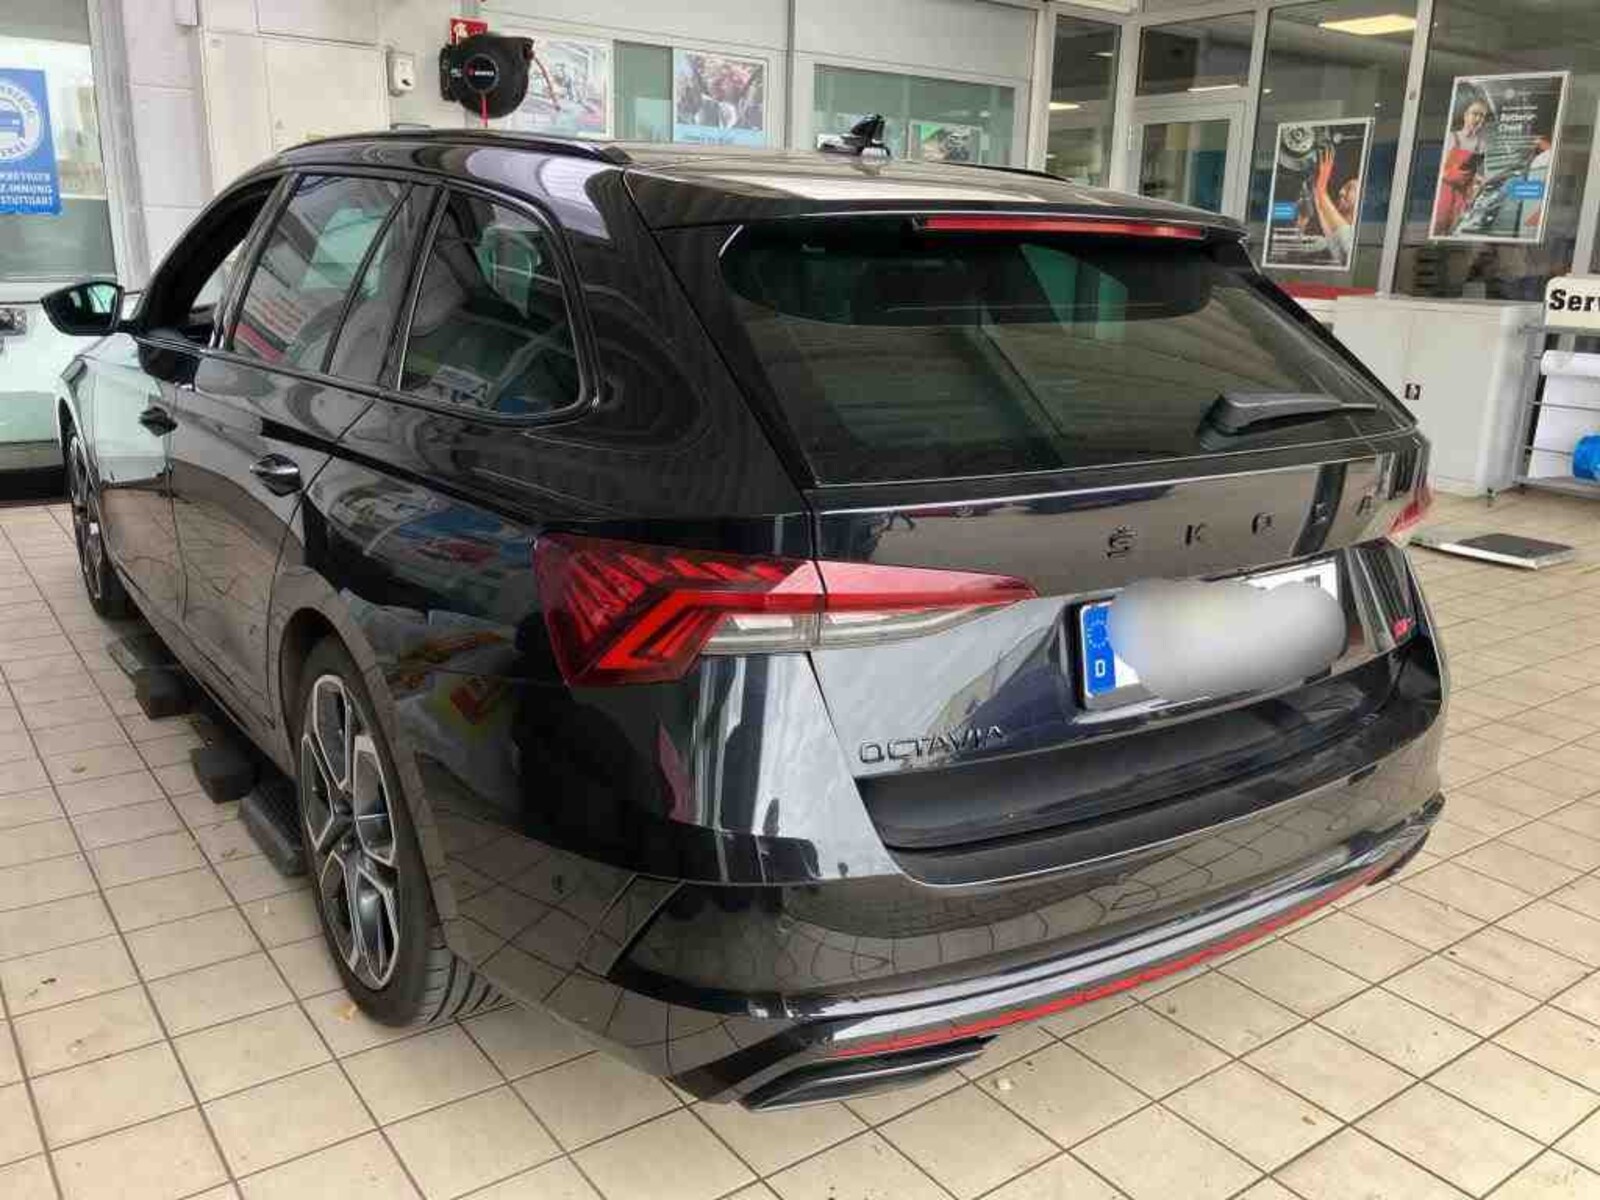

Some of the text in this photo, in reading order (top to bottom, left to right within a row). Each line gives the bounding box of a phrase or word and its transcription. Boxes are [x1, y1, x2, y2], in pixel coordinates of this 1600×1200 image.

[1549, 289, 1600, 311] Ser
[1095, 659, 1105, 678] D
[860, 725, 1003, 764] OCTAVIA
